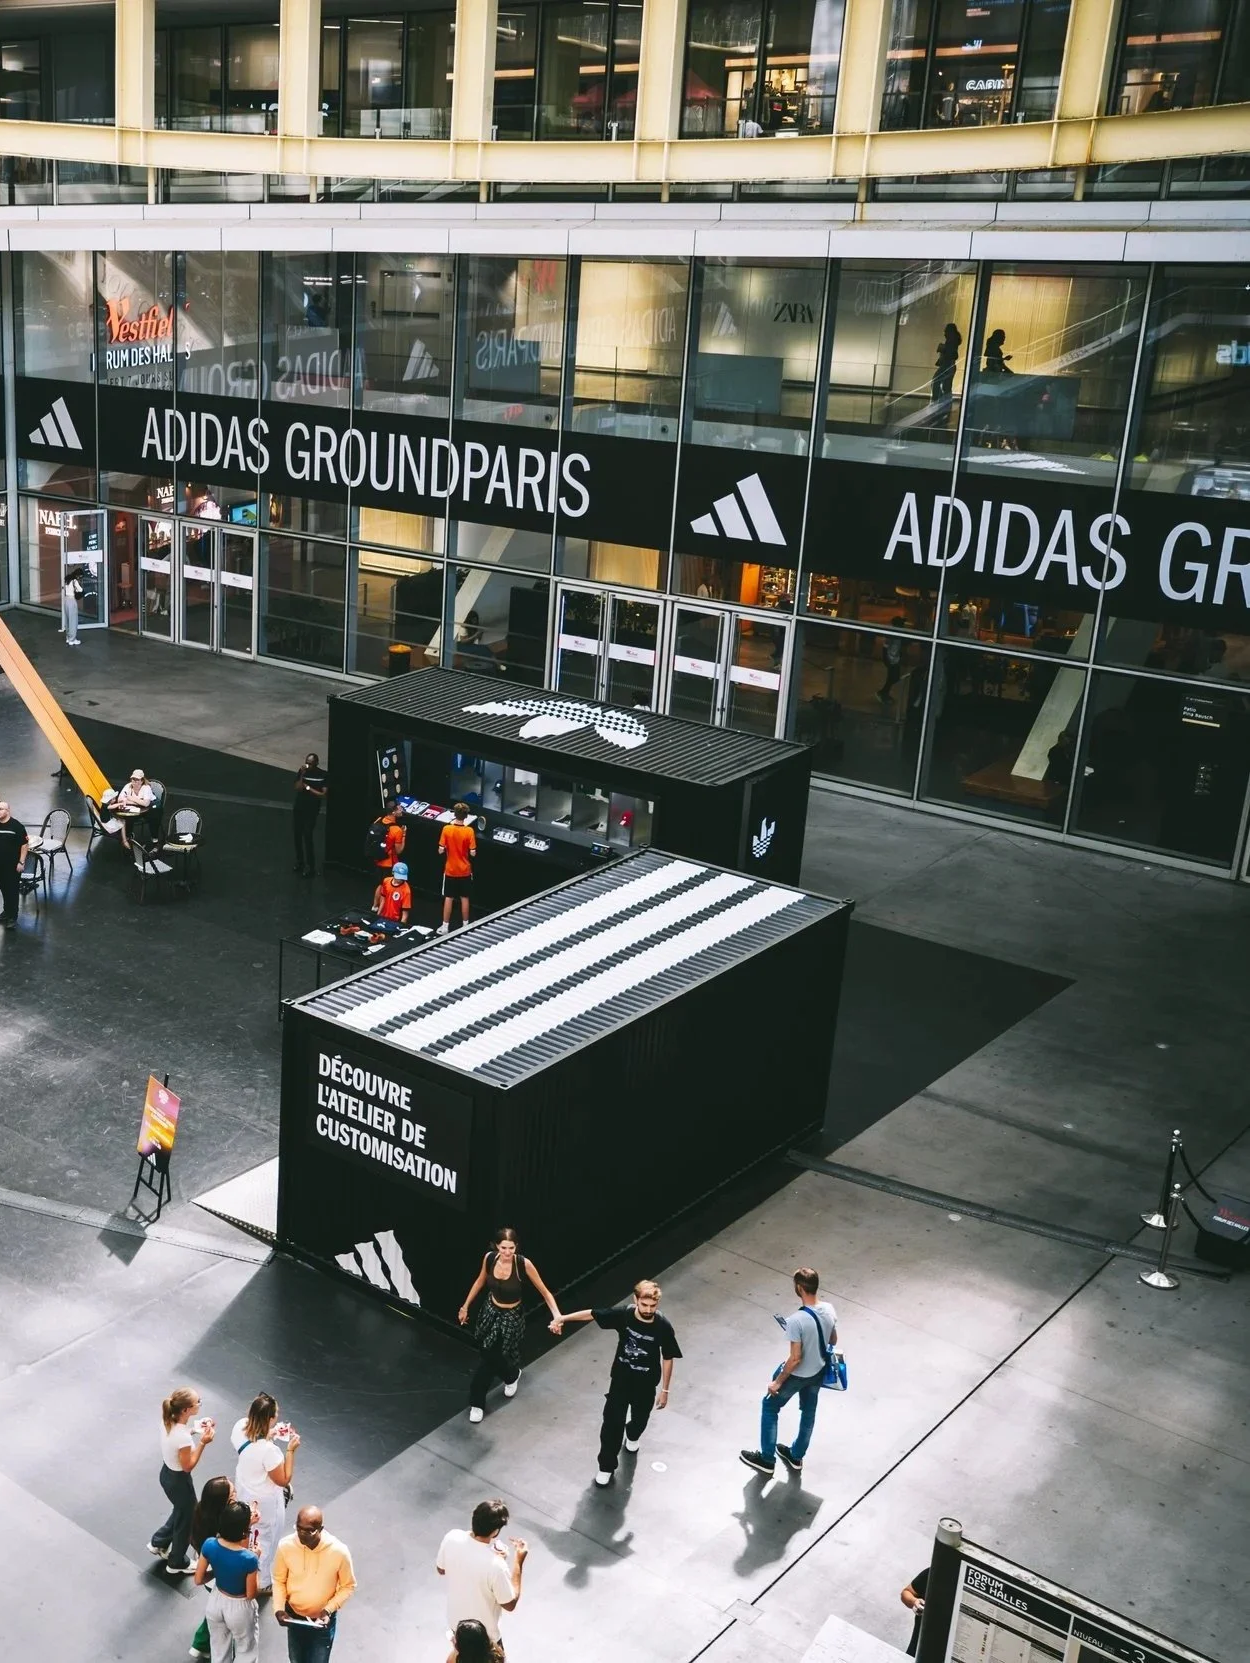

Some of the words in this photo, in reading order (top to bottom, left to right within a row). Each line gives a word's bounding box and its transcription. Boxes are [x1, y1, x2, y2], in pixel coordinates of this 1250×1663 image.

[131, 346, 150, 367] DES
[141, 407, 270, 475] ADIDAS
[285, 422, 591, 518] GROUNDPARIS
[883, 492, 1131, 591] ADIDAS
[319, 1053, 412, 1112] DÉCOUVRE
[317, 1083, 395, 1137] L'ATELIER
[401, 1118, 427, 1149] DE
[316, 1114, 457, 1194] CUSTOMISATION
[967, 1576, 986, 1591] DES
[989, 1586, 1028, 1611] HALLES
[968, 1569, 1003, 1590] FORUM
[1073, 1629, 1103, 1648] NIVEAU
